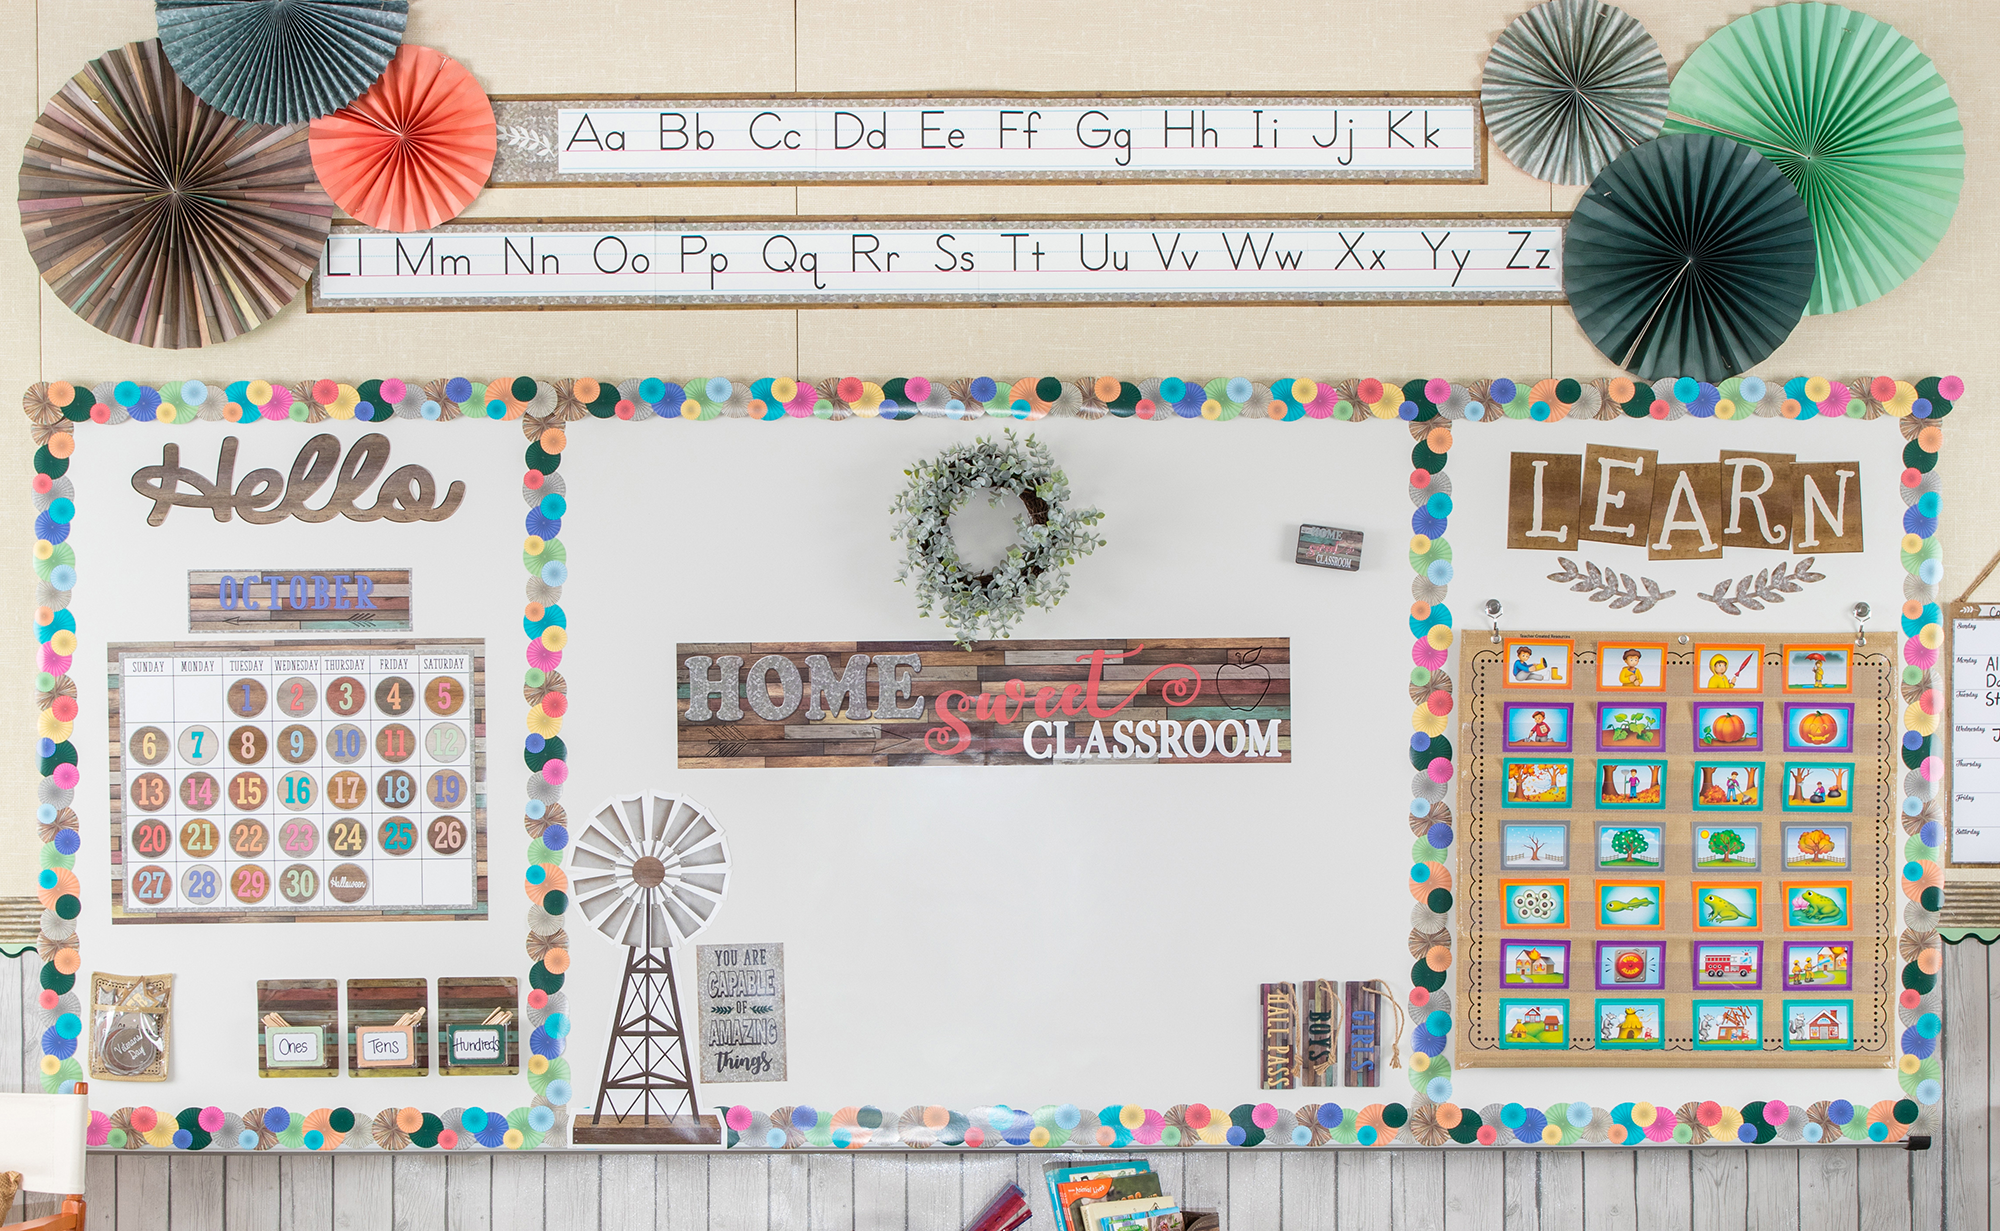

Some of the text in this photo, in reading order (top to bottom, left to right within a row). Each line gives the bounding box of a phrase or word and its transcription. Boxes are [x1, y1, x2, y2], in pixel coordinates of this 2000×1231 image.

[567, 111, 1439, 166] Aa Bb Cc Dd Ee Ff Gg Hh Ii Jj Kk
[327, 232, 1549, 290] Ll Mm Nn Oo Pp Qq Rr Ss Tt Uu Vv Ww Xx Yy Zz
[131, 433, 466, 527] Hello
[1525, 456, 1855, 552] LEARN
[1311, 527, 1343, 540] HOME
[1316, 554, 1352, 568] CLASSROOM
[219, 575, 378, 611] OCTOBER
[132, 658, 465, 673] SUNDAY MONDAY TUESDAY WEDNESDAY THURSDAY FRIDAY SATURDAY
[242, 683, 451, 711] 1 2 3 4 5
[684, 653, 925, 722] HOME
[142, 729, 458, 760] 6 7 8 9 10 11 12
[1023, 717, 1284, 759] CLASSROOM
[138, 775, 459, 806] 13 14 15 16 17 18 19
[139, 821, 461, 852] 20 21 22 23 24 25 26
[139, 870, 367, 898] 27 28 29 30 Halloween
[715, 949, 767, 966] YOU ARE
[707, 969, 776, 998] CAPABLE
[736, 1001, 748, 1014] OF
[279, 1038, 309, 1055] Ones
[368, 1037, 400, 1055] Tens
[452, 1036, 500, 1052] Hundreds
[708, 1018, 778, 1047] AMAZING
[1267, 993, 1290, 1087] HALL PASS
[1309, 1010, 1332, 1061] BOYS
[1351, 1010, 1375, 1071] GIRLS
[127, 1045, 146, 1060] Day
